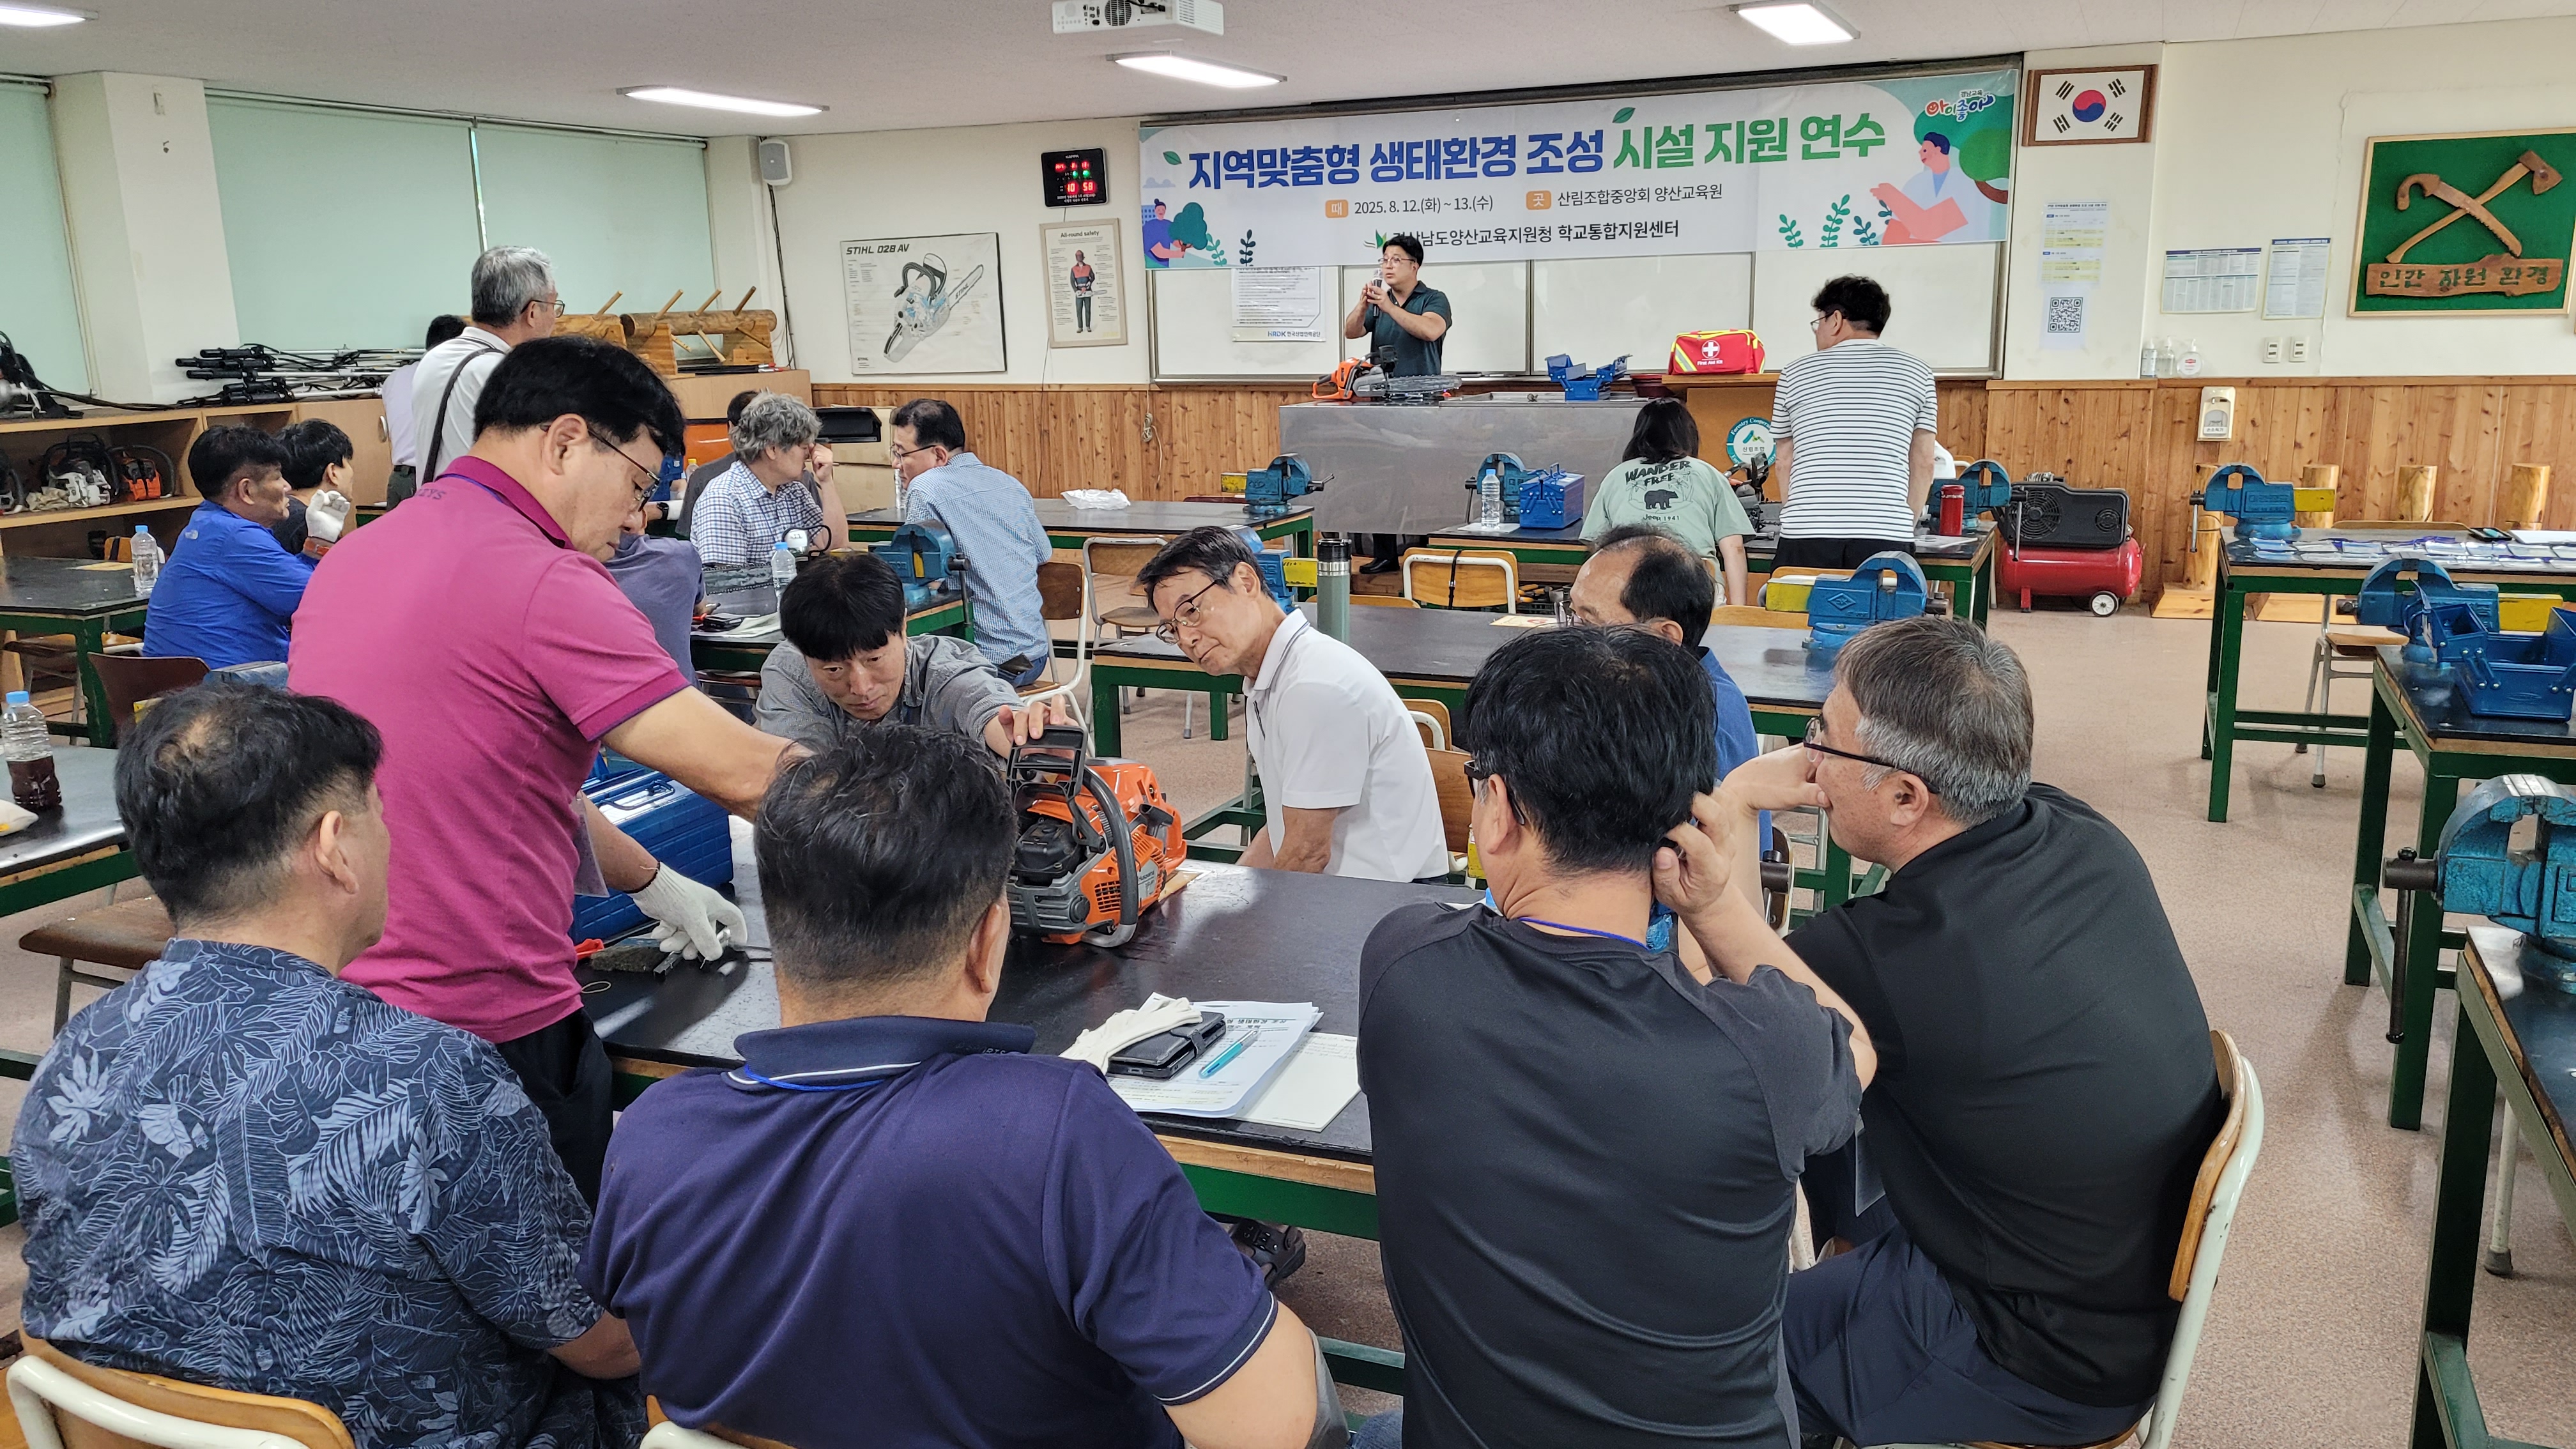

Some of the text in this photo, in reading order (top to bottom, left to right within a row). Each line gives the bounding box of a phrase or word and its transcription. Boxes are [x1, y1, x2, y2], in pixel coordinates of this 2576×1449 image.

[1188, 112, 1886, 190] 지역맞춤형 생태환경 조성 시설 지원 연수
[1331, 202, 1342, 216] 때
[1354, 201, 1386, 214] 2025.
[1389, 200, 1400, 213] 8.
[1402, 197, 1441, 214] 12.(화)
[1453, 195, 1494, 213] 13.(수)
[1533, 183, 1723, 207] 곳 산림조합중앙회 양산교육원
[1558, 220, 1680, 241] 학교통합지원센터
[846, 245, 875, 255] STIHL
[897, 243, 910, 252] AV
[2380, 266, 2549, 288] 인간 자원 환경
[1730, 418, 1771, 436] Forestry Coopera
[1625, 460, 1692, 486] WANDER
[1644, 472, 1675, 487] FREE
